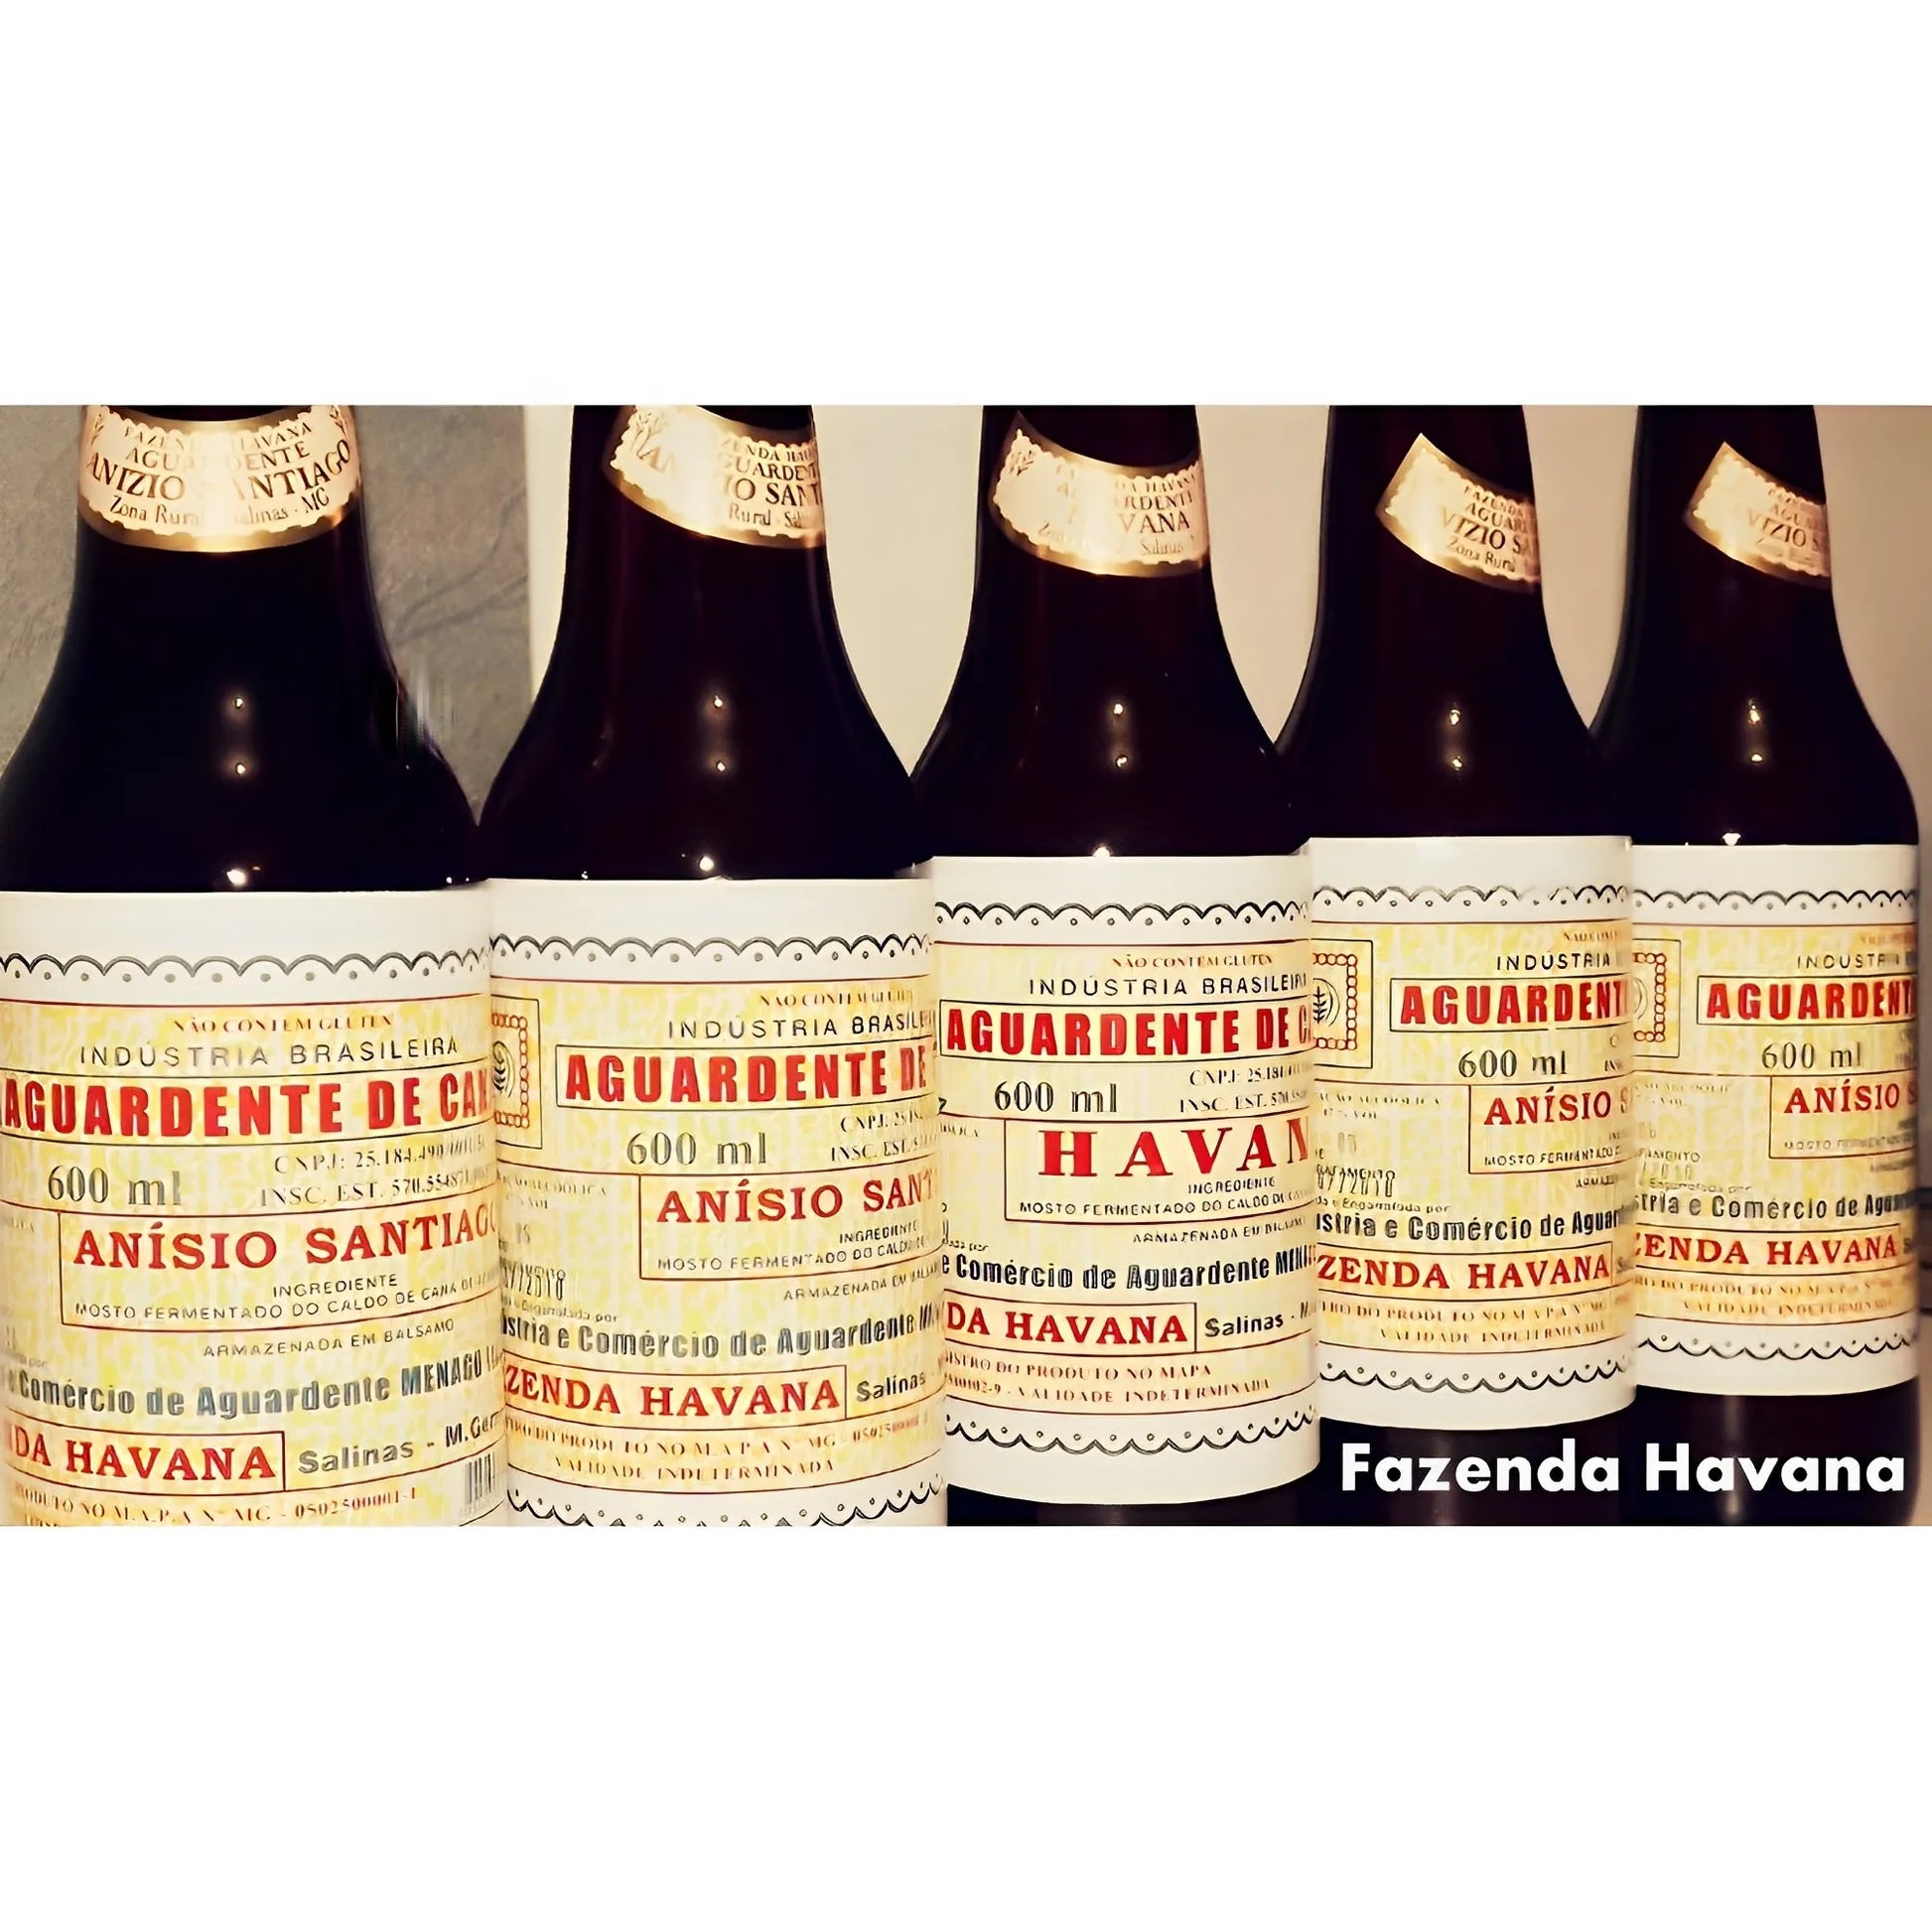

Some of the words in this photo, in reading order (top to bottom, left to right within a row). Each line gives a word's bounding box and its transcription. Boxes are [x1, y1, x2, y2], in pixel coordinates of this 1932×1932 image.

[109, 494, 147, 521] Zona
[1496, 950, 1610, 971] INDÚSTRIA
[1029, 975, 1187, 997] INDÚSTRIA
[1400, 979, 1627, 1026] AGUARDENT
[1707, 978, 1916, 1021] AGUARDENT
[668, 1012, 839, 1039] INDÚSTRIA
[947, 1008, 1240, 1056] AGUARDENTE
[1256, 1007, 1289, 1050] DE
[80, 1040, 269, 1067] INDÚSTRIA
[290, 1036, 459, 1065] BRASILEIRA
[1458, 1049, 1518, 1078] 600
[1532, 1050, 1567, 1075] ml
[1761, 1042, 1815, 1069] 600
[1830, 1042, 1862, 1068] ml
[566, 1048, 888, 1103] AGUARDENTE
[900, 1044, 927, 1091] DE
[1, 1077, 344, 1137] AGUARDENTE
[368, 1075, 422, 1129] DE
[994, 1081, 1054, 1113] 600
[1071, 1083, 1118, 1113] ml
[1483, 1086, 1611, 1126] ANÍSIO
[1784, 1078, 1900, 1114] ANÍSIO
[625, 1131, 697, 1167] 600
[717, 1132, 766, 1166] ml
[1038, 1115, 1309, 1177] HAVAN
[1484, 1154, 1535, 1167] MOSTO
[48, 1164, 109, 1203] 600
[128, 1171, 181, 1205] ml
[656, 1178, 843, 1224] ANÍSIO
[1020, 1201, 1076, 1215] MOSTO
[1083, 1201, 1196, 1216] FERMENTADO
[1202, 1200, 1222, 1212] DO
[1228, 1194, 1269, 1210] CALDO
[1689, 1197, 1702, 1216] e
[1712, 1194, 1828, 1219] Comércio
[1836, 1195, 1859, 1217] de
[1384, 1217, 1398, 1238] e
[1408, 1214, 1532, 1241] Comércio
[1541, 1211, 1566, 1237] de
[72, 1221, 277, 1270] ANÍSIO
[657, 1257, 723, 1272] MOSTO
[731, 1251, 847, 1271] FERMENTADO
[853, 1247, 873, 1261] DO
[1767, 1234, 1897, 1265] HAVANA
[273, 1274, 399, 1298] INGREDIENTE
[942, 1254, 950, 1275] e
[956, 1253, 1072, 1290] Comércio
[1082, 1263, 1116, 1290] de
[1127, 1256, 1270, 1292] Aguardente
[1317, 1254, 1449, 1290] ZENDA
[1468, 1254, 1610, 1290] HAVANA
[75, 1302, 136, 1318] MOSTO
[145, 1303, 282, 1319] FERMENTADO
[293, 1302, 319, 1317] DO
[328, 1296, 387, 1313] CALDO
[396, 1292, 415, 1305] DE
[204, 1339, 343, 1357] ARMAZENADA
[350, 1333, 375, 1348] EM
[384, 1318, 455, 1343] BALSAMO
[558, 1326, 570, 1349] e
[578, 1322, 720, 1358] Comércio
[731, 1328, 767, 1357] de
[776, 1313, 915, 1355] Aguardente
[1005, 1310, 1187, 1344] HAVANA
[1204, 1313, 1284, 1338] Salinas
[1027, 1364, 1119, 1381] PRODUTO
[19, 1369, 135, 1414] Comércio
[146, 1387, 185, 1417] de
[198, 1373, 390, 1419] Aguardente
[504, 1364, 621, 1415] ZENDA
[640, 1379, 841, 1417] HAVANA
[856, 1374, 927, 1402] Salinas
[1125, 1378, 1270, 1403] INDETERMINADA
[67, 1440, 276, 1479] HAVANA
[298, 1442, 415, 1474] Salinas
